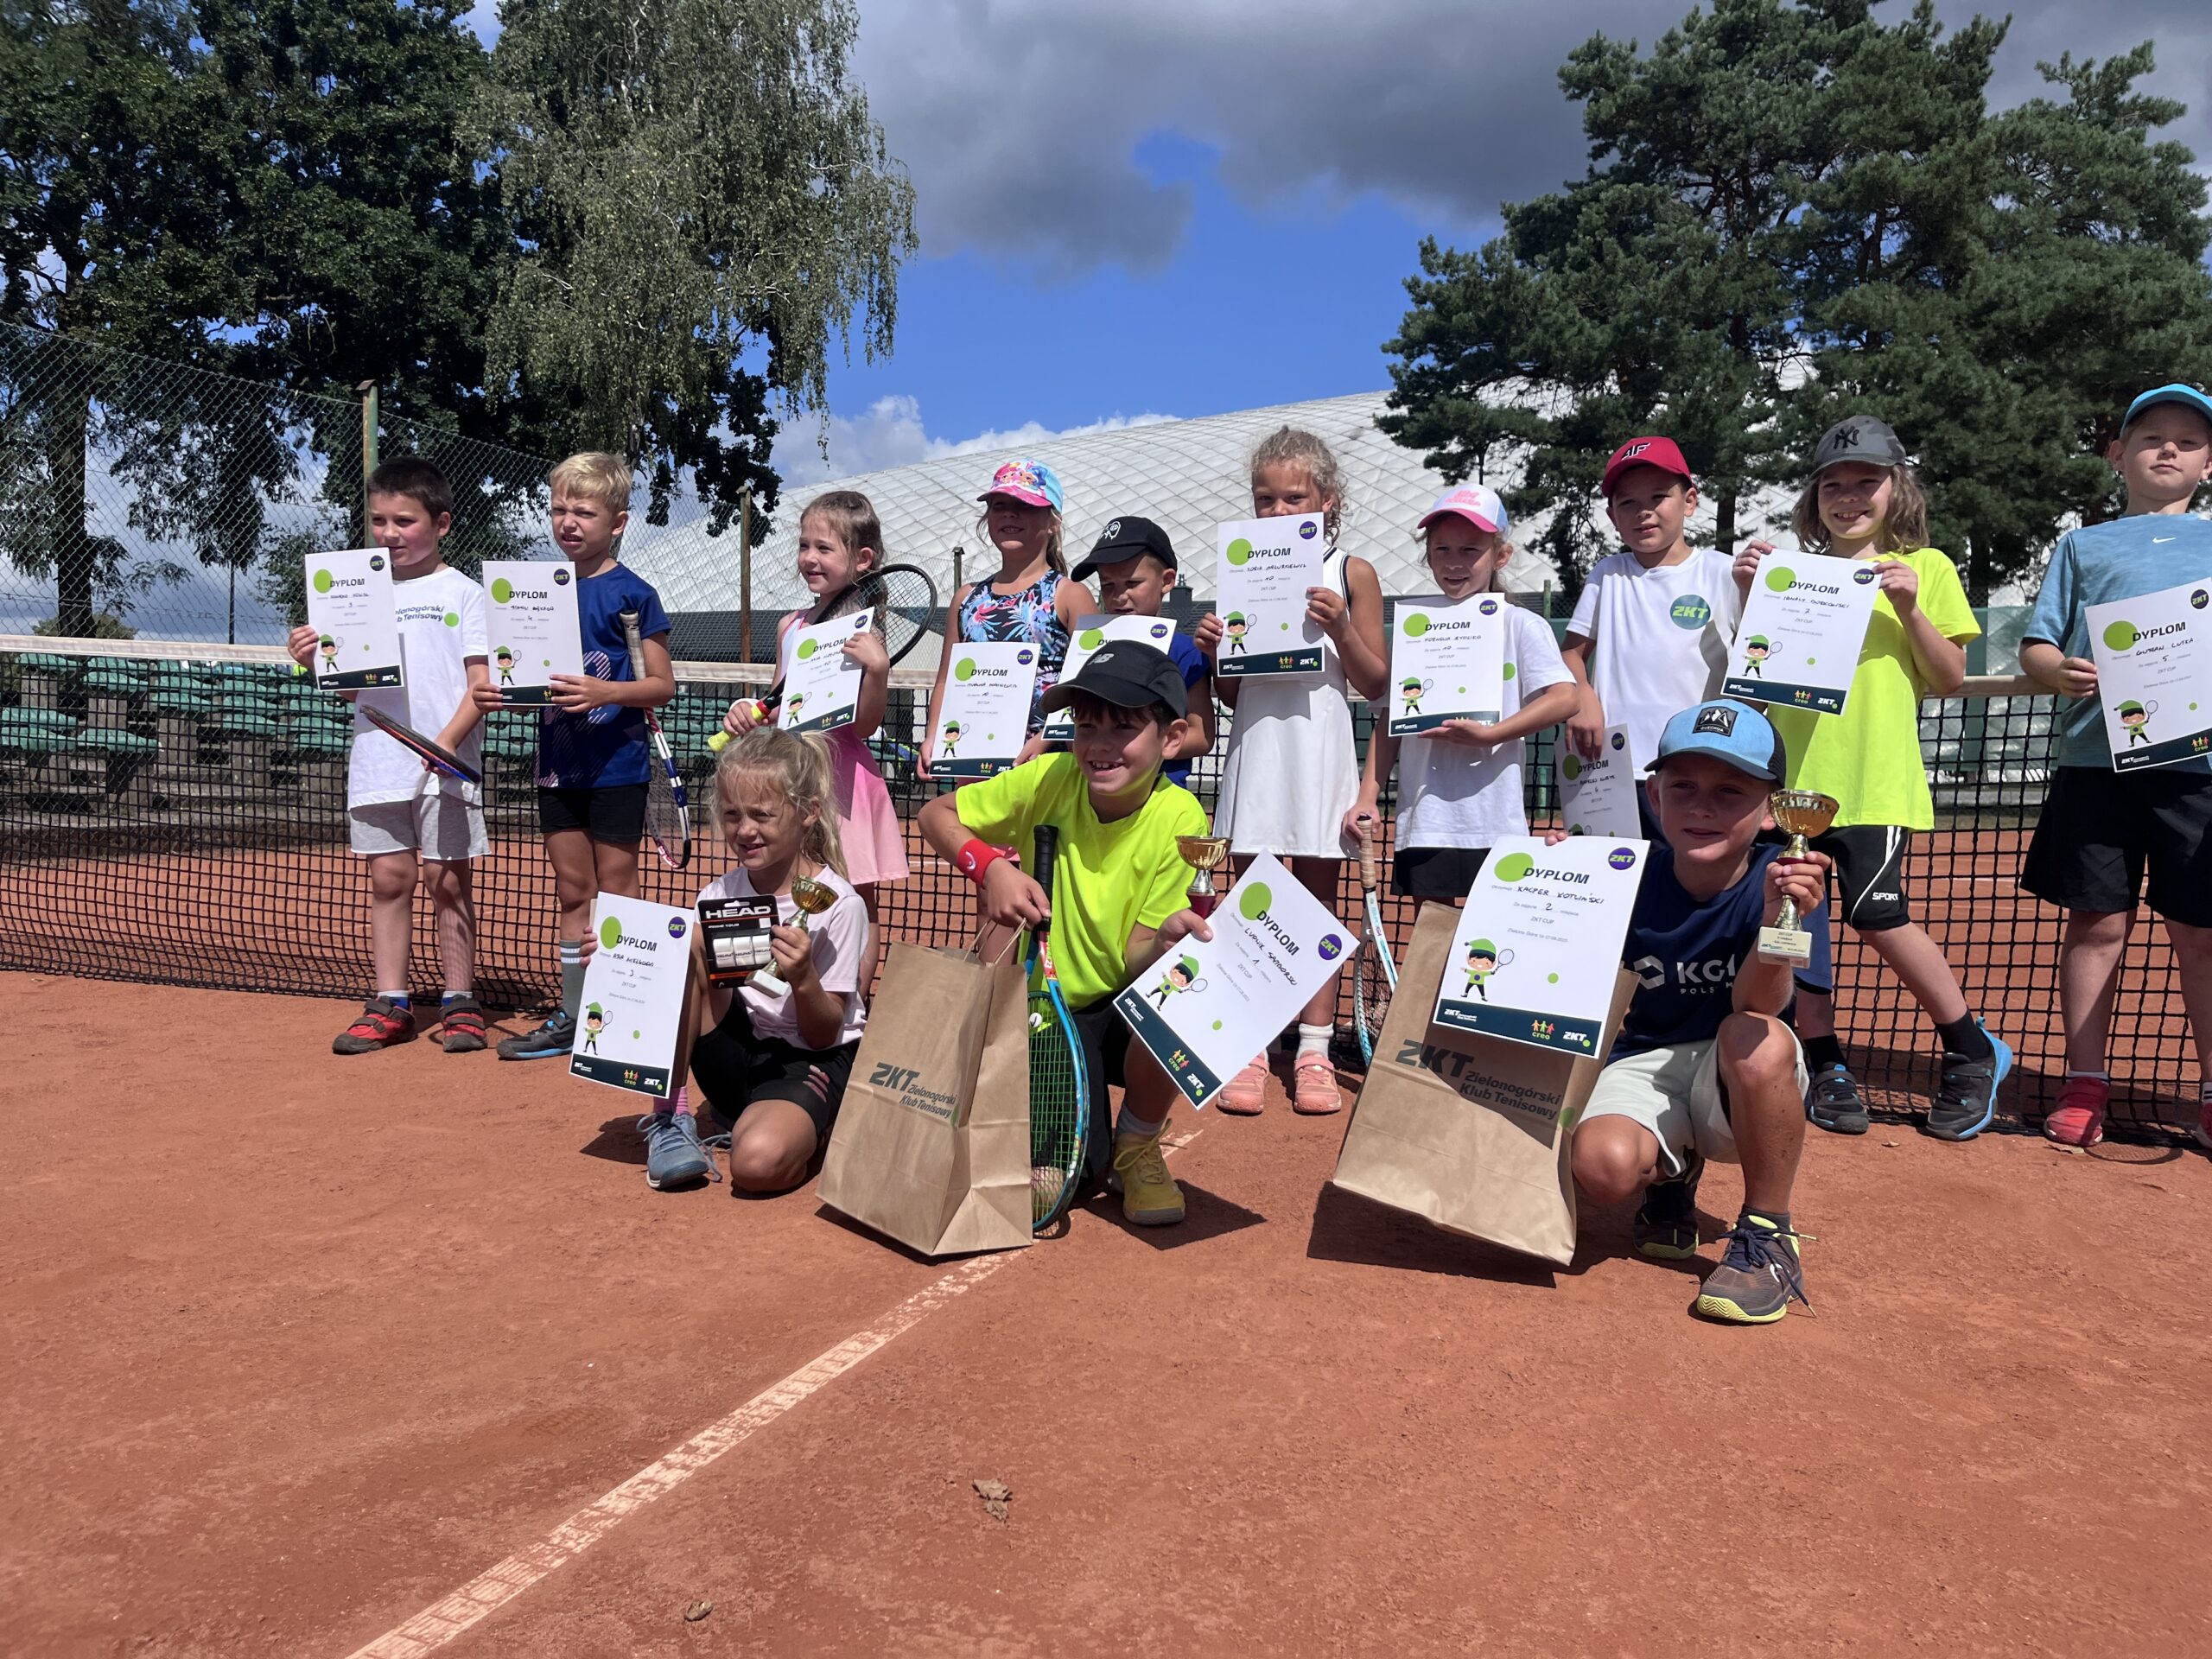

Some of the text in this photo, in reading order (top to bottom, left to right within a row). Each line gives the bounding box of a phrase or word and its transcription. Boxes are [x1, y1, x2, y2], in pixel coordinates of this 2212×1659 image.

[1247, 547, 1291, 559] DYPLOM
[329, 578, 365, 588] DYPLOM
[1788, 581, 1840, 594] DYPLOM
[2192, 594, 2208, 605] ZKT
[395, 605, 445, 615] lonogórski
[1673, 605, 1710, 620] ZKT
[1425, 621, 1471, 632] DYPLOM
[2132, 621, 2186, 642] DYPLOM
[812, 637, 847, 653] DYPLOM
[1577, 760, 1609, 773] DYPLOM
[1609, 854, 1635, 863] ZKT
[1522, 867, 1590, 885] DYPLOM
[1516, 886, 1549, 896] KACPER
[1872, 892, 1899, 901] SPORT
[705, 906, 772, 919] HEAD
[1545, 902, 1553, 911] 2
[669, 923, 686, 931] ZKT
[1256, 910, 1300, 956] DYPLOM
[616, 934, 657, 952] DYPLOM
[1320, 938, 1340, 957] ZKT
[1532, 1032, 1550, 1040] creo
[1562, 1031, 1587, 1042] ZKT
[1168, 1058, 1180, 1071] creo
[1395, 1039, 1562, 1106] ZKT Zielonogórski
[644, 1077, 660, 1086] ZKT
[868, 1061, 956, 1106] ZKT Zielonogórski
[1186, 1073, 1205, 1090] ZKT
[899, 1095, 952, 1119] Klub Tenisowy
[1459, 1083, 1557, 1121] Klub Tenisowy
